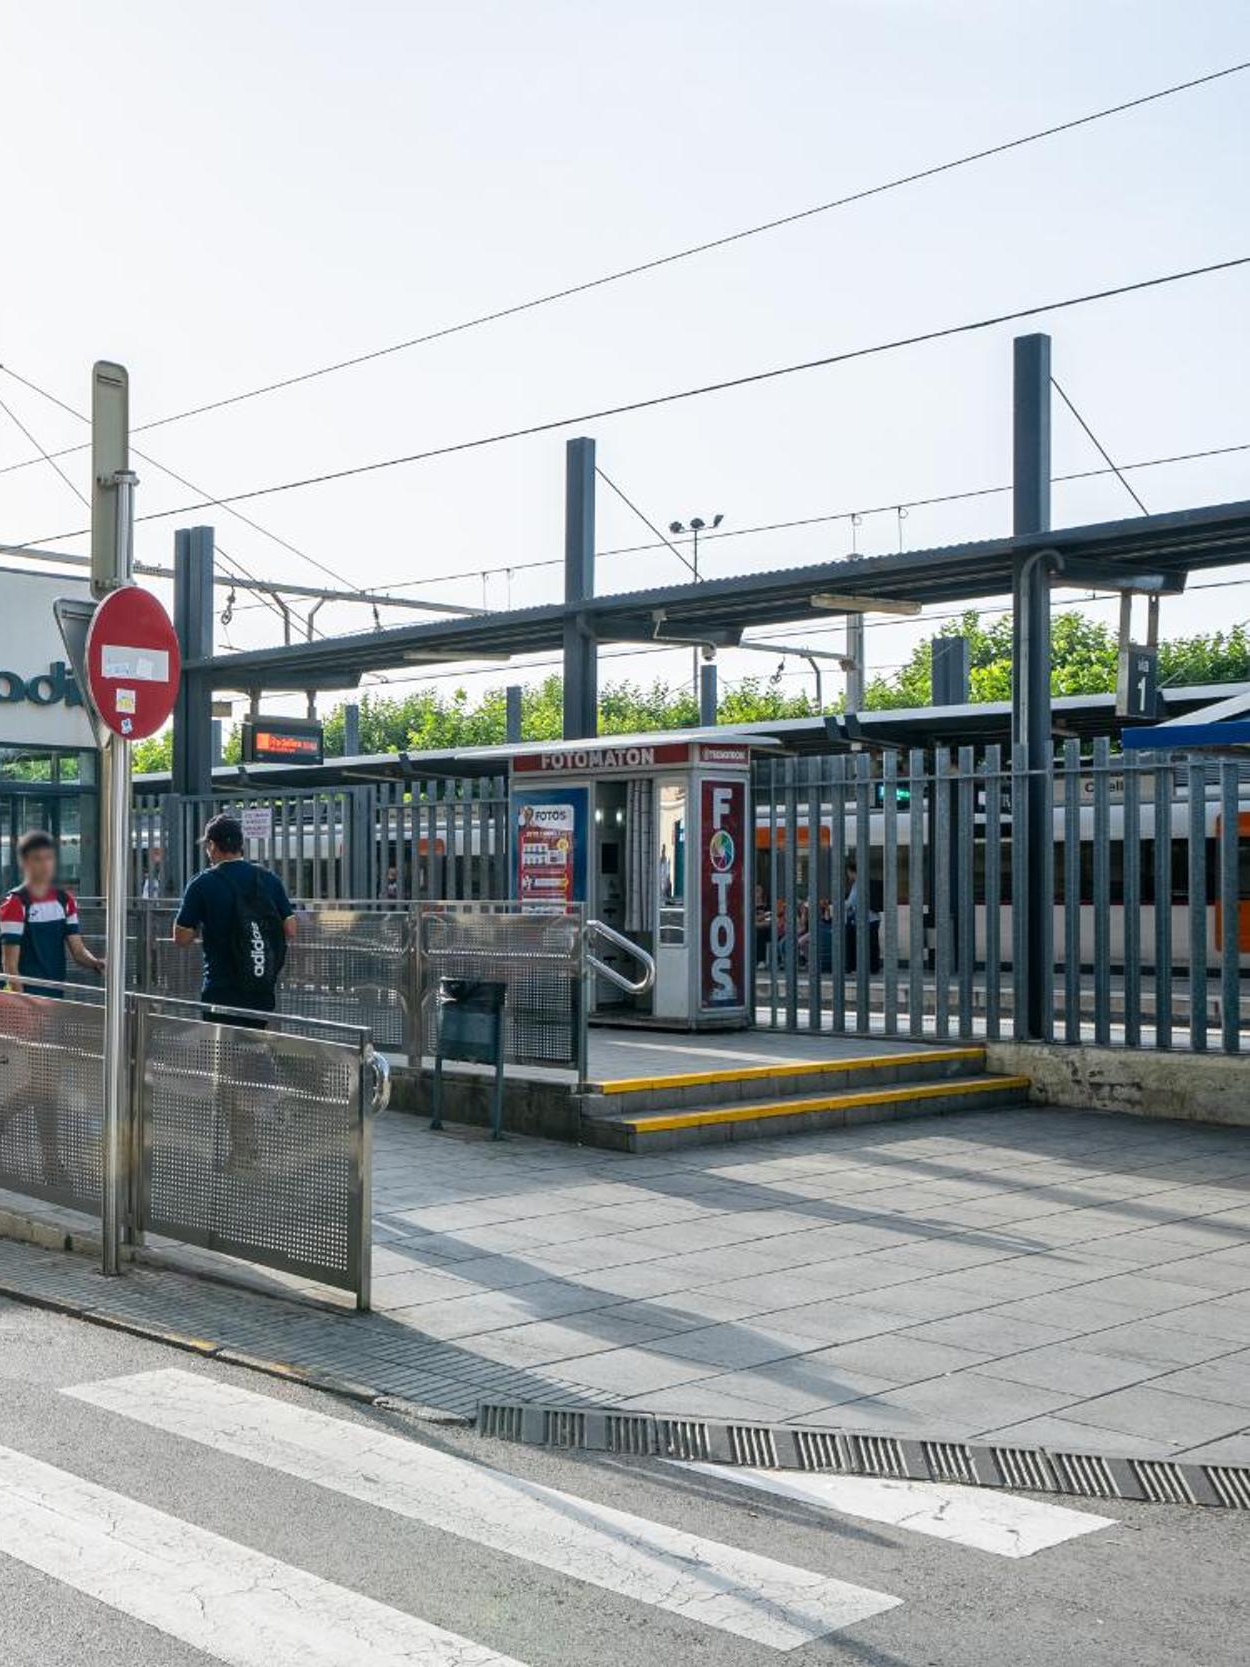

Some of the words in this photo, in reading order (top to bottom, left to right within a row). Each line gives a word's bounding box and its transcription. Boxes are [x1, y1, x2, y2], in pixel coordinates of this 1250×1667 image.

[1137, 676, 1146, 711] 1
[541, 747, 654, 770] FOTOMATON
[535, 810, 567, 821] FOTOS
[710, 787, 736, 1000] FOTOS
[251, 921, 265, 977] adidas
